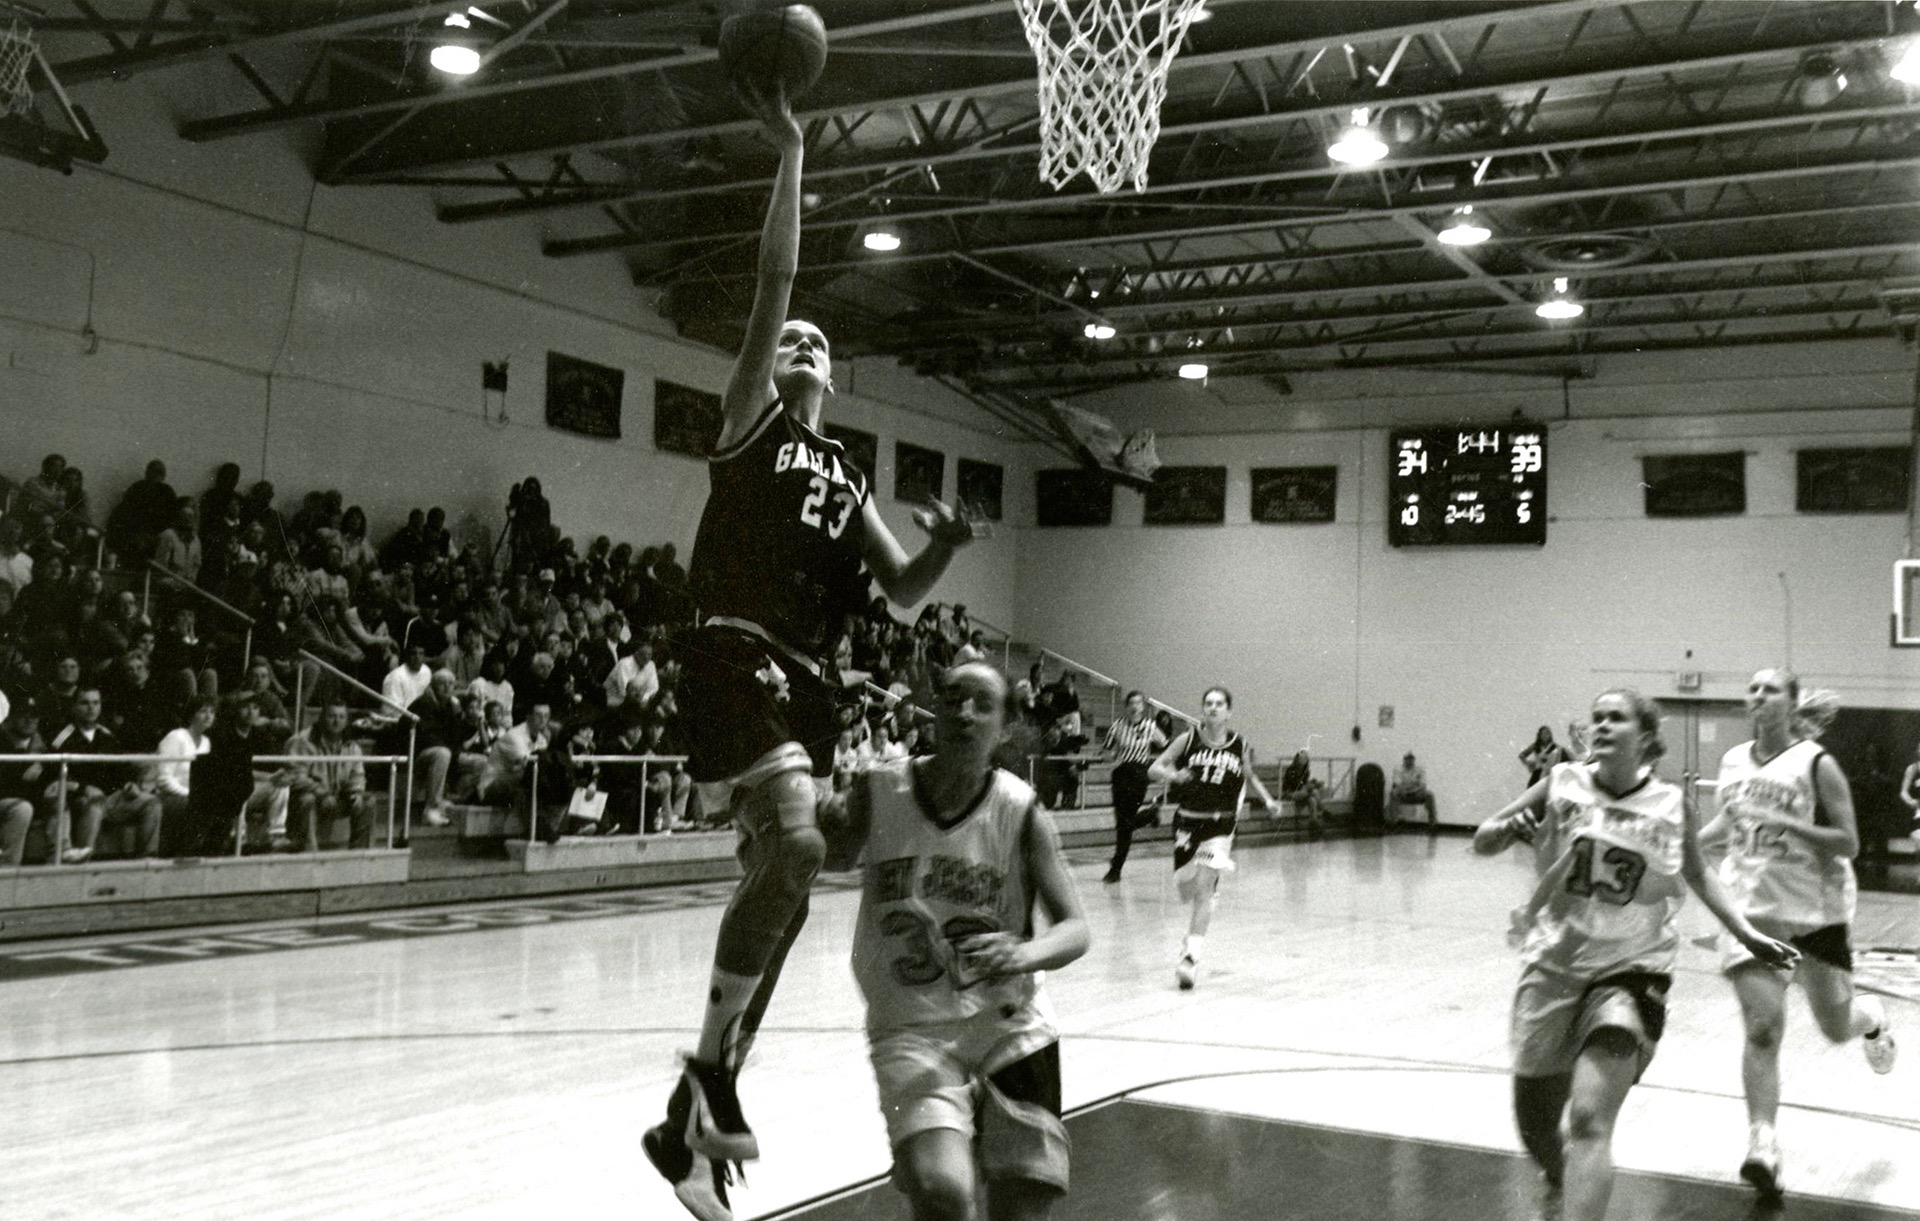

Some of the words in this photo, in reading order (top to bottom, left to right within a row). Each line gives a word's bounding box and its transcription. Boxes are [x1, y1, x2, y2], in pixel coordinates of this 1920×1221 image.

[775, 442, 860, 503] GALLA
[1398, 450, 1427, 476] 34
[1511, 445, 1541, 472] 39
[801, 476, 856, 540] 23
[1401, 505, 1418, 525] 10
[1565, 836, 1647, 906] 13
